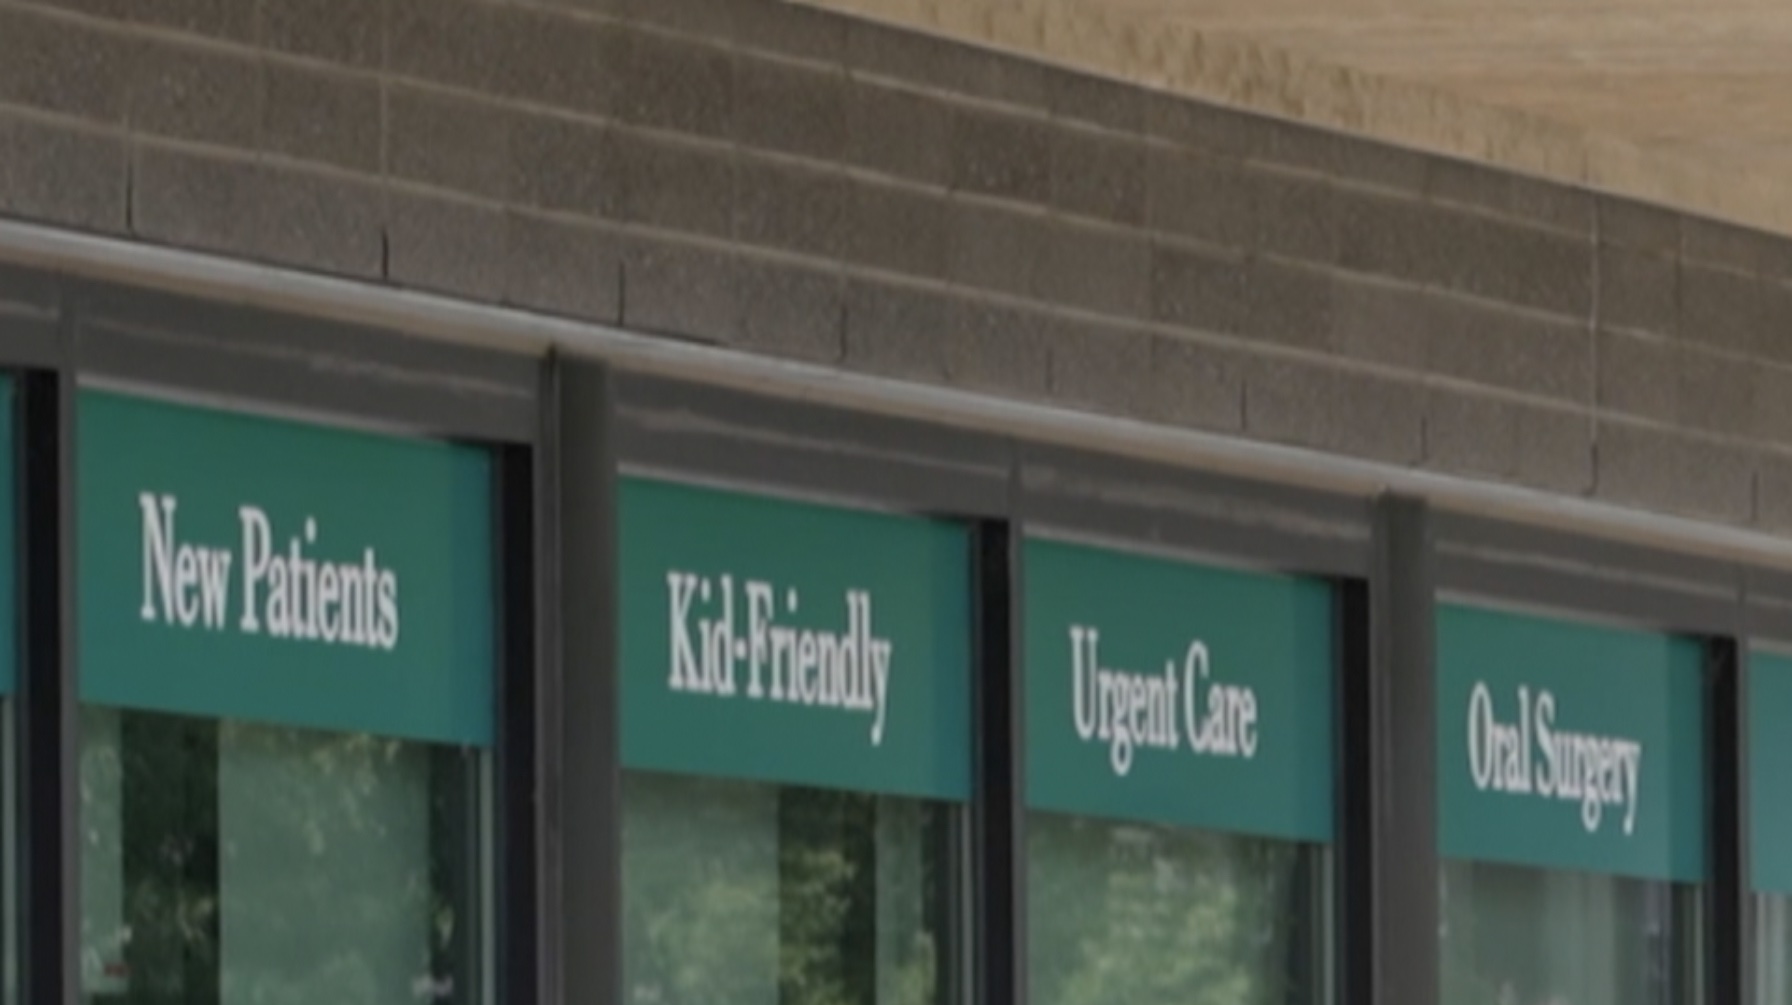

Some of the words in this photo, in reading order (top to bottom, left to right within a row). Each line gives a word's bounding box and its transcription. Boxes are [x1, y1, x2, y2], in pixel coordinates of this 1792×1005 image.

[139, 493, 232, 630] New
[239, 506, 398, 649] Patients
[667, 572, 891, 744] Kid-Friendly
[1069, 626, 1180, 775] Urgent
[1184, 640, 1257, 757] Care
[1467, 682, 1532, 795] Oral
[1534, 691, 1641, 833] Surgery
